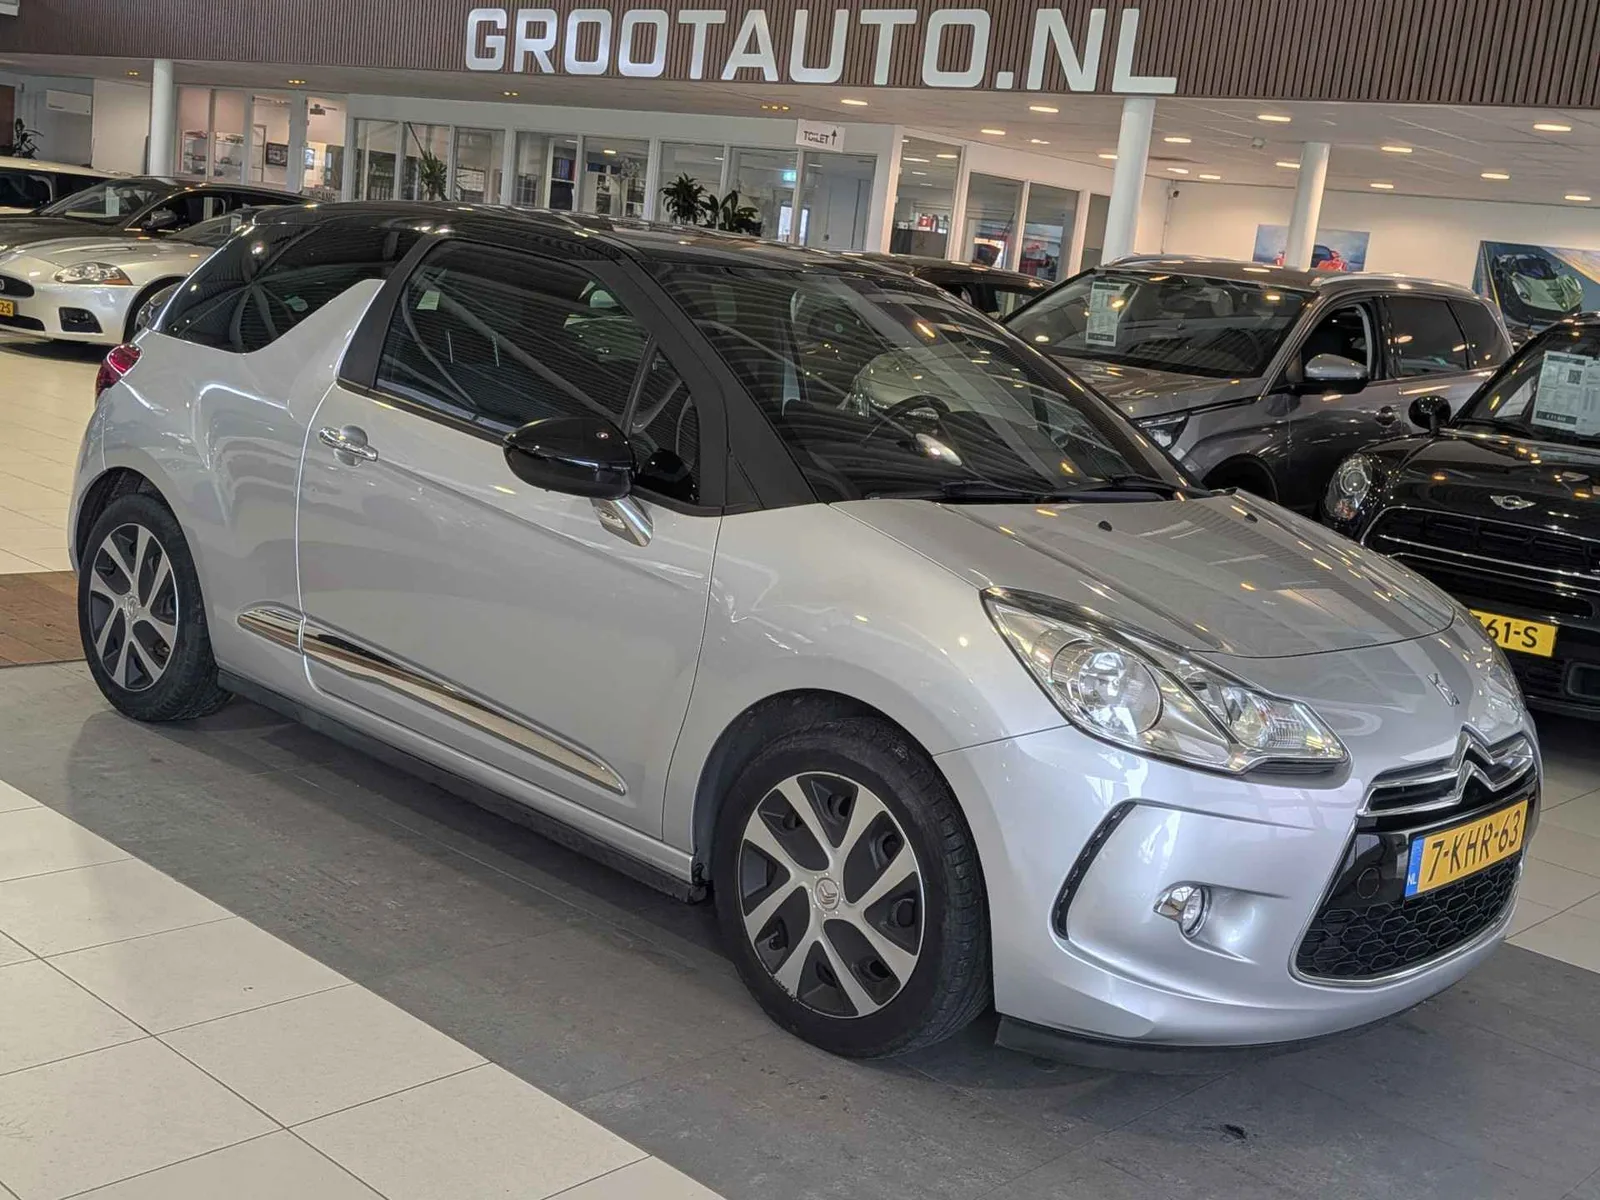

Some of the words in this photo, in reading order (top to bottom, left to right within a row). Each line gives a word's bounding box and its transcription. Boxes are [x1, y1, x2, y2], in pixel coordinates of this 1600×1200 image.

[465, 8, 1178, 95] GROOTAUTO.NL
[803, 130, 829, 145] TOILET
[1473, 614, 1538, 648] 61-S
[1428, 810, 1521, 883] 7-KHR-63
[1407, 873, 1417, 885] NL
